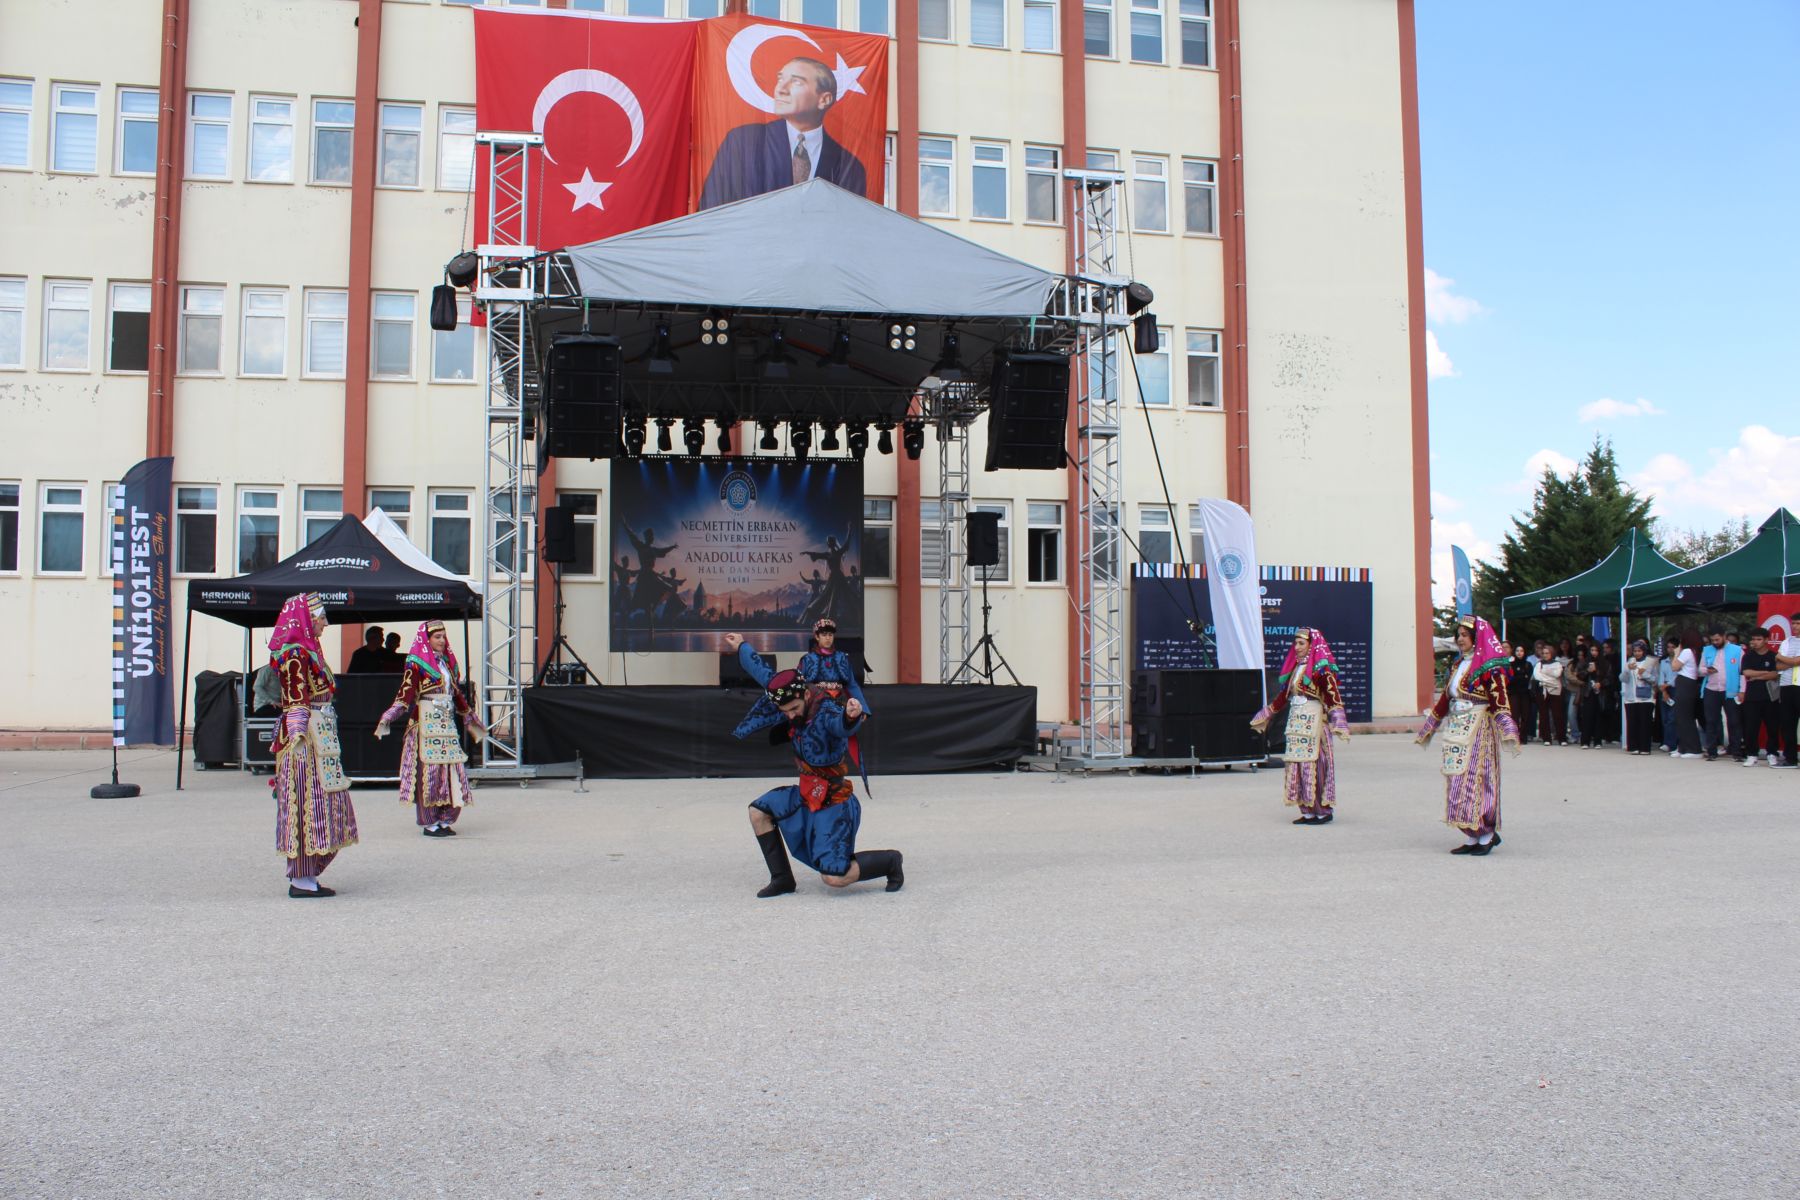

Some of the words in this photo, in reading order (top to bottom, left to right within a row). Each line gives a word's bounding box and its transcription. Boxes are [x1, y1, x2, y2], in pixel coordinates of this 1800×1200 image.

[681, 519, 744, 532] NECMETTİN
[747, 521, 797, 532] ERBAKAN
[705, 533, 773, 543] ÜNİVERSİTESİ
[684, 551, 744, 563] ANADOLU
[748, 551, 793, 563] KAFKAS
[698, 566, 724, 574] HALK
[729, 566, 780, 575] DANSLARI
[127, 505, 154, 678] ÜNİ101FEST
[318, 591, 348, 601] MONİK
